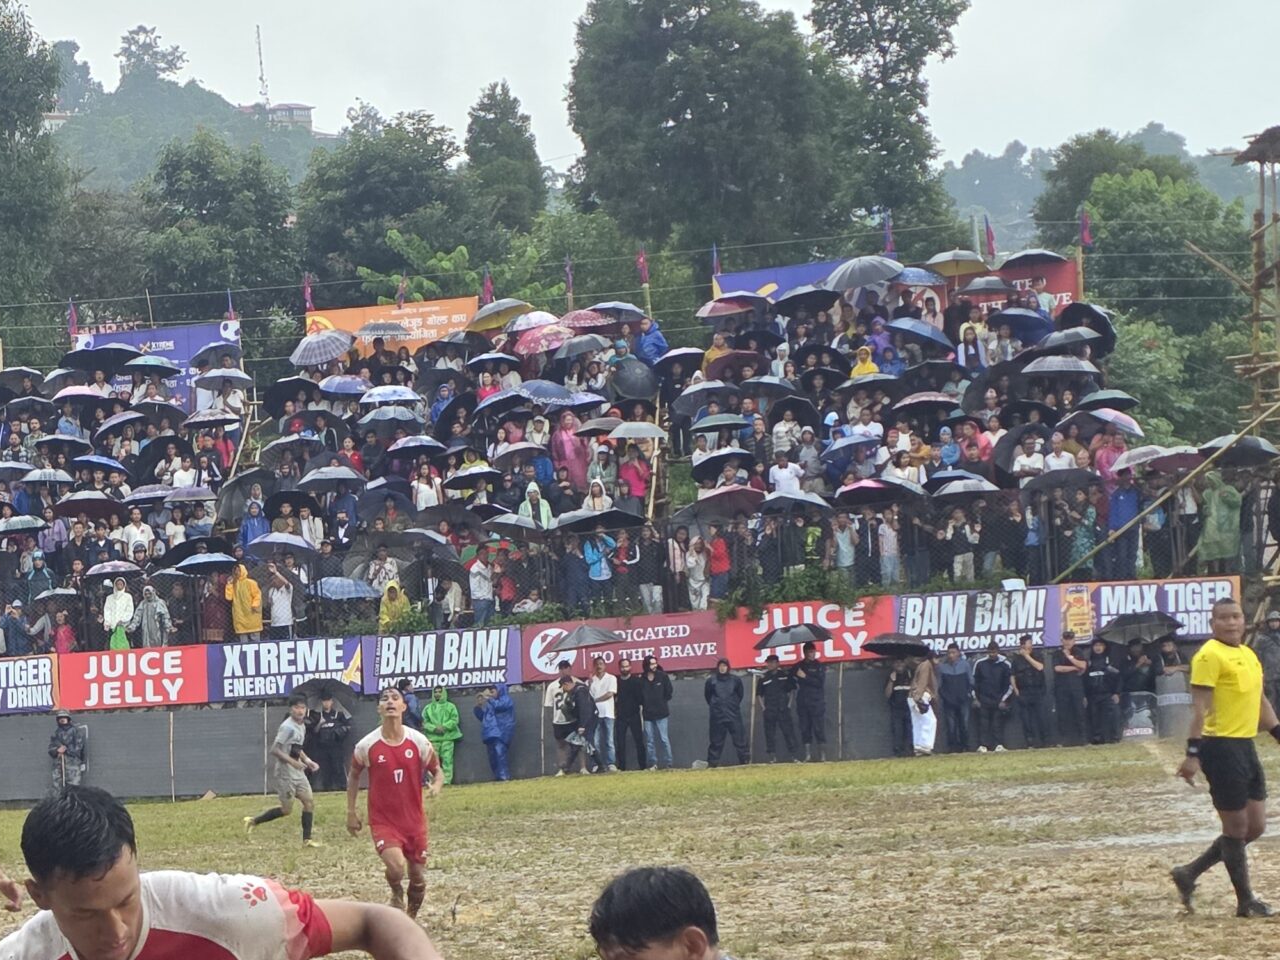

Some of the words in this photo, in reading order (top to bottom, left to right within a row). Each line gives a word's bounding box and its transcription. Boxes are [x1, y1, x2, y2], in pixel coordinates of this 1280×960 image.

[905, 594, 968, 636] BAM
[974, 588, 1047, 632] BAM!
[1100, 584, 1158, 615] MAX
[753, 602, 866, 635] JUICE
[84, 650, 182, 680] JUICE
[223, 638, 344, 677] XTREME
[380, 633, 437, 675] BAM
[443, 628, 508, 670] BAM!
[619, 647, 655, 661] THE
[660, 642, 718, 658] BRAVE
[224, 675, 286, 698] ENERGY
[462, 669, 506, 684] DRINK
[7, 684, 53, 708] DRINK
[84, 678, 184, 706] JELLY
[393, 768, 404, 784] 17
